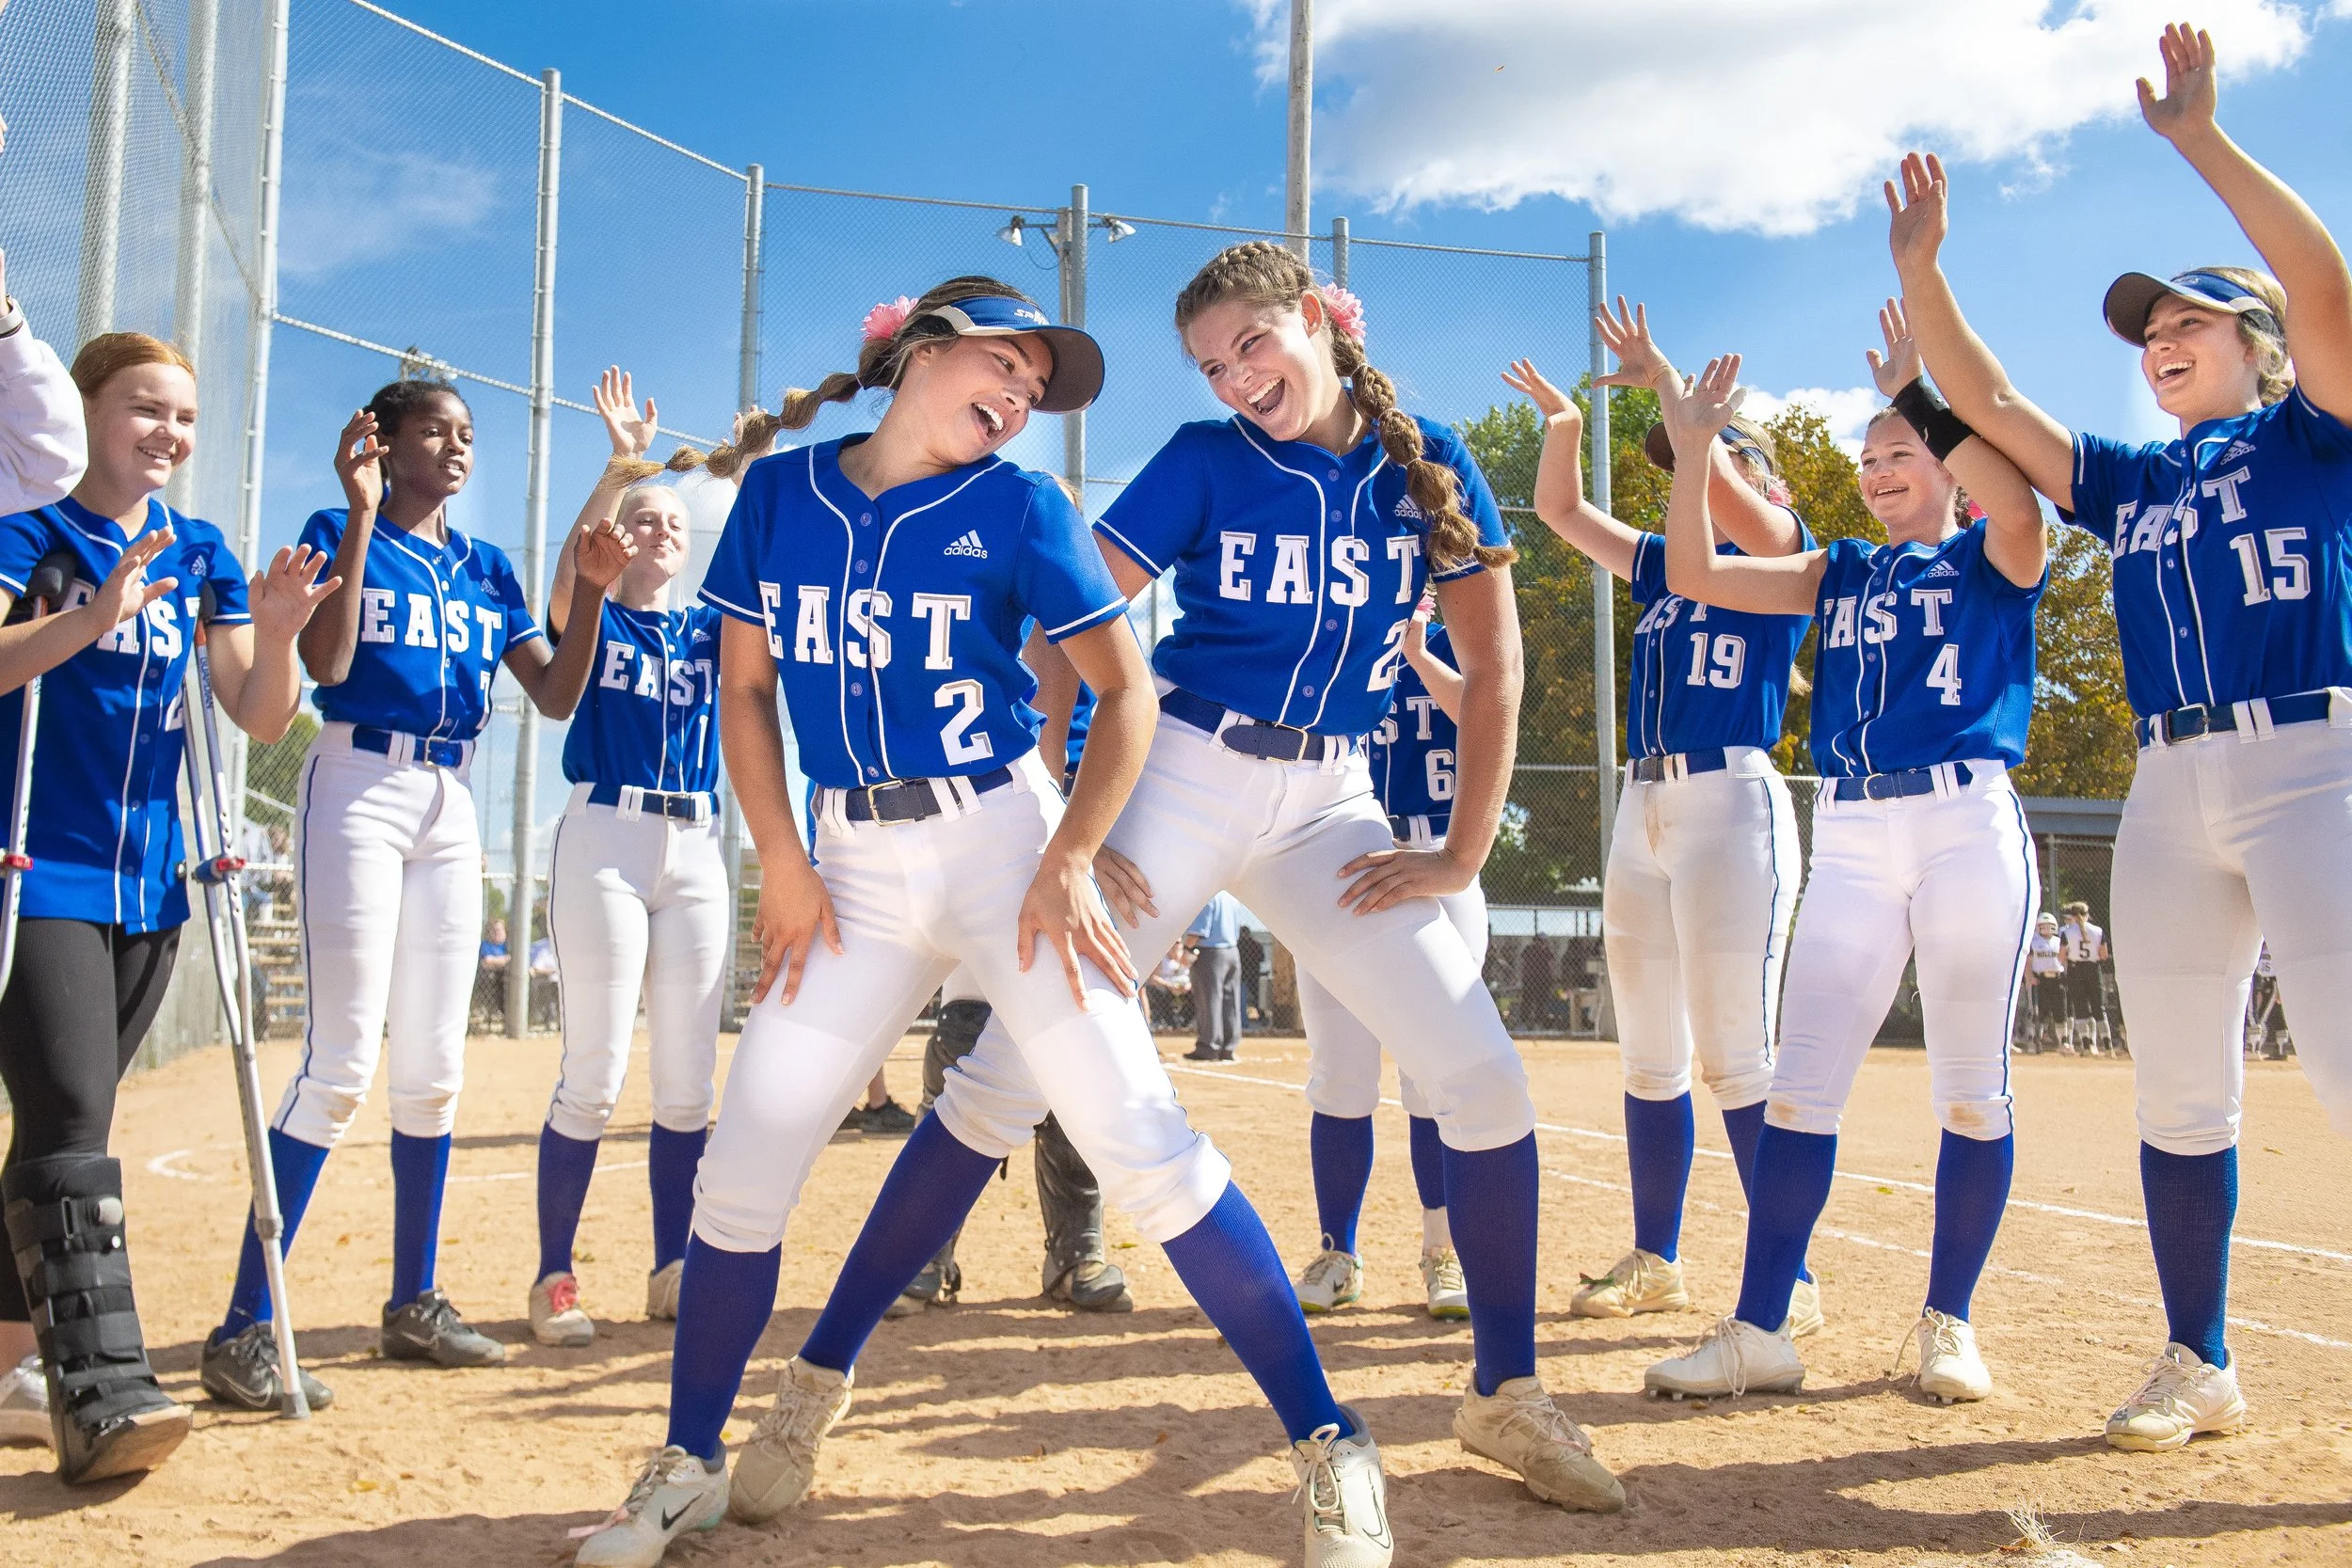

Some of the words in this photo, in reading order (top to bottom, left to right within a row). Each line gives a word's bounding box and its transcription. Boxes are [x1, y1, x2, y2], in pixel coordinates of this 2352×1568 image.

[2220, 444, 2257, 466] adidas
[2113, 466, 2251, 562] EAST
[944, 546, 988, 559] adidas
[1219, 531, 1420, 607] EAST
[1928, 569, 1960, 578] adidas
[2230, 527, 2311, 607] 15
[361, 588, 501, 661] EAST
[759, 580, 972, 670] EAST
[1367, 618, 1408, 692] 2
[599, 641, 712, 705] EAST
[1687, 632, 1746, 689] 19
[1927, 643, 1962, 705] 4
[934, 679, 993, 766] 2
[1425, 749, 1454, 801] 6
[2079, 941, 2090, 958] 5
